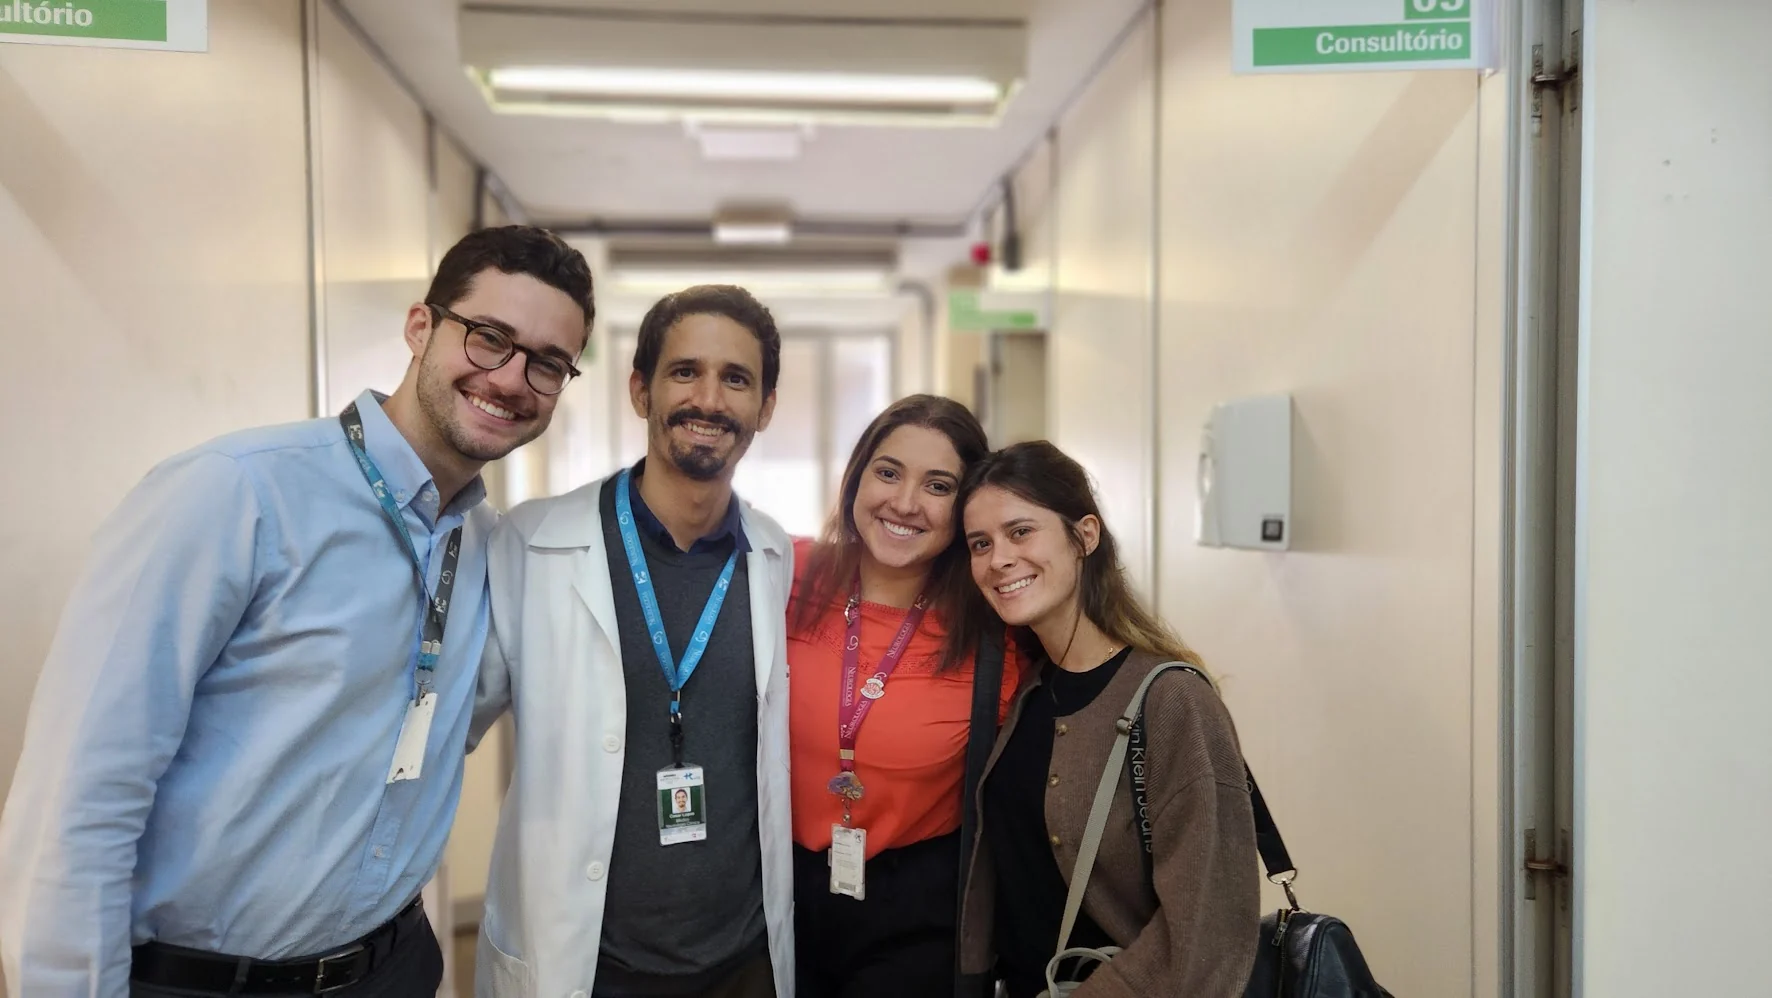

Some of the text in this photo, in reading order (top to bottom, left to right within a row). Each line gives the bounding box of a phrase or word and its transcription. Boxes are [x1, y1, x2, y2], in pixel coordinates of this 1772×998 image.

[1316, 29, 1462, 54] Consultório
[887, 622, 912, 658] NEUROLOGIA
[845, 667, 856, 707] NEUROLOGIA
[1131, 747, 1146, 792] Klein
